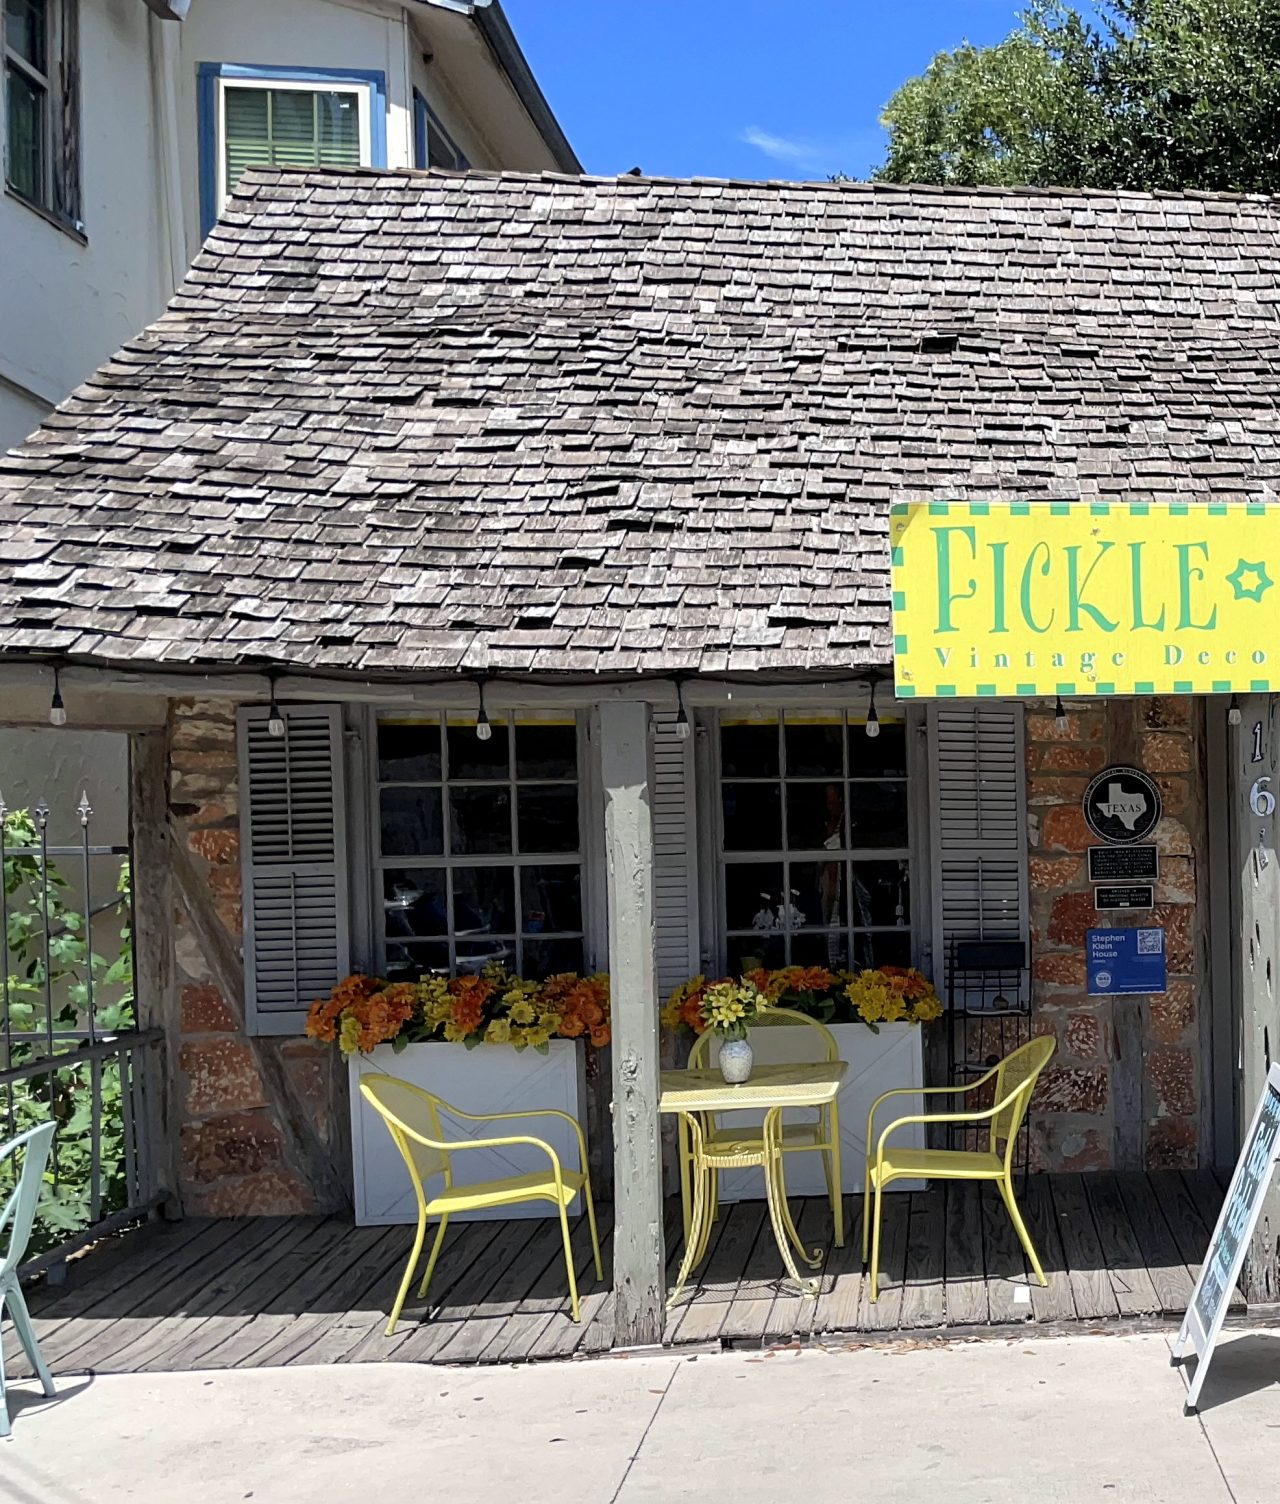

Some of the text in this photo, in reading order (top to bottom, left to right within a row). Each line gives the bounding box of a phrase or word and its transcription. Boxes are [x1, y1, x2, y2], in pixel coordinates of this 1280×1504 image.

[932, 525, 1218, 634] FICKLE
[934, 647, 1126, 673] Vintage
[1106, 803, 1142, 813] TEXAS
[1091, 934, 1126, 944] Stephen
